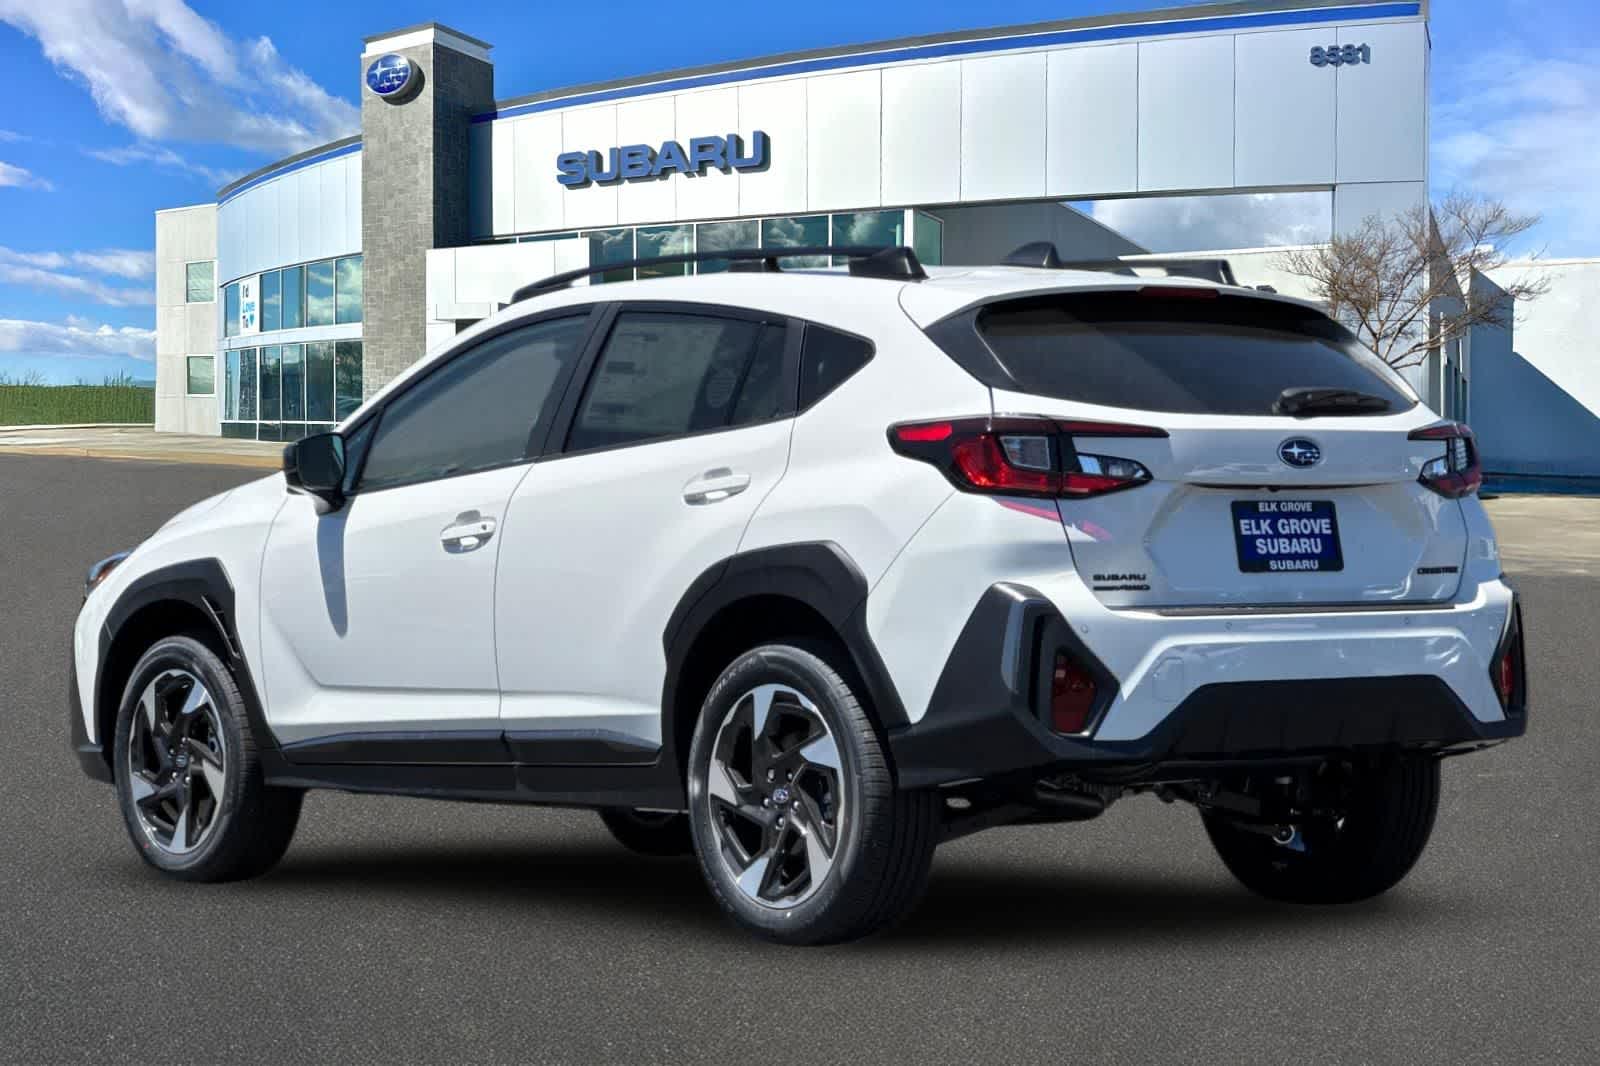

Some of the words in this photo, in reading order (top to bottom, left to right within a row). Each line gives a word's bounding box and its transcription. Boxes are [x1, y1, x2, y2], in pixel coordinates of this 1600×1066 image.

[556, 130, 770, 190] SUBARU
[1258, 502, 1278, 512] ELK
[1280, 502, 1313, 512] GROVE
[1240, 519, 1274, 535] ELK
[1277, 518, 1332, 535] GROVE
[1256, 538, 1322, 554] SUBARU
[1269, 560, 1319, 570] SUBARU
[1093, 573, 1147, 581] SUBARU
